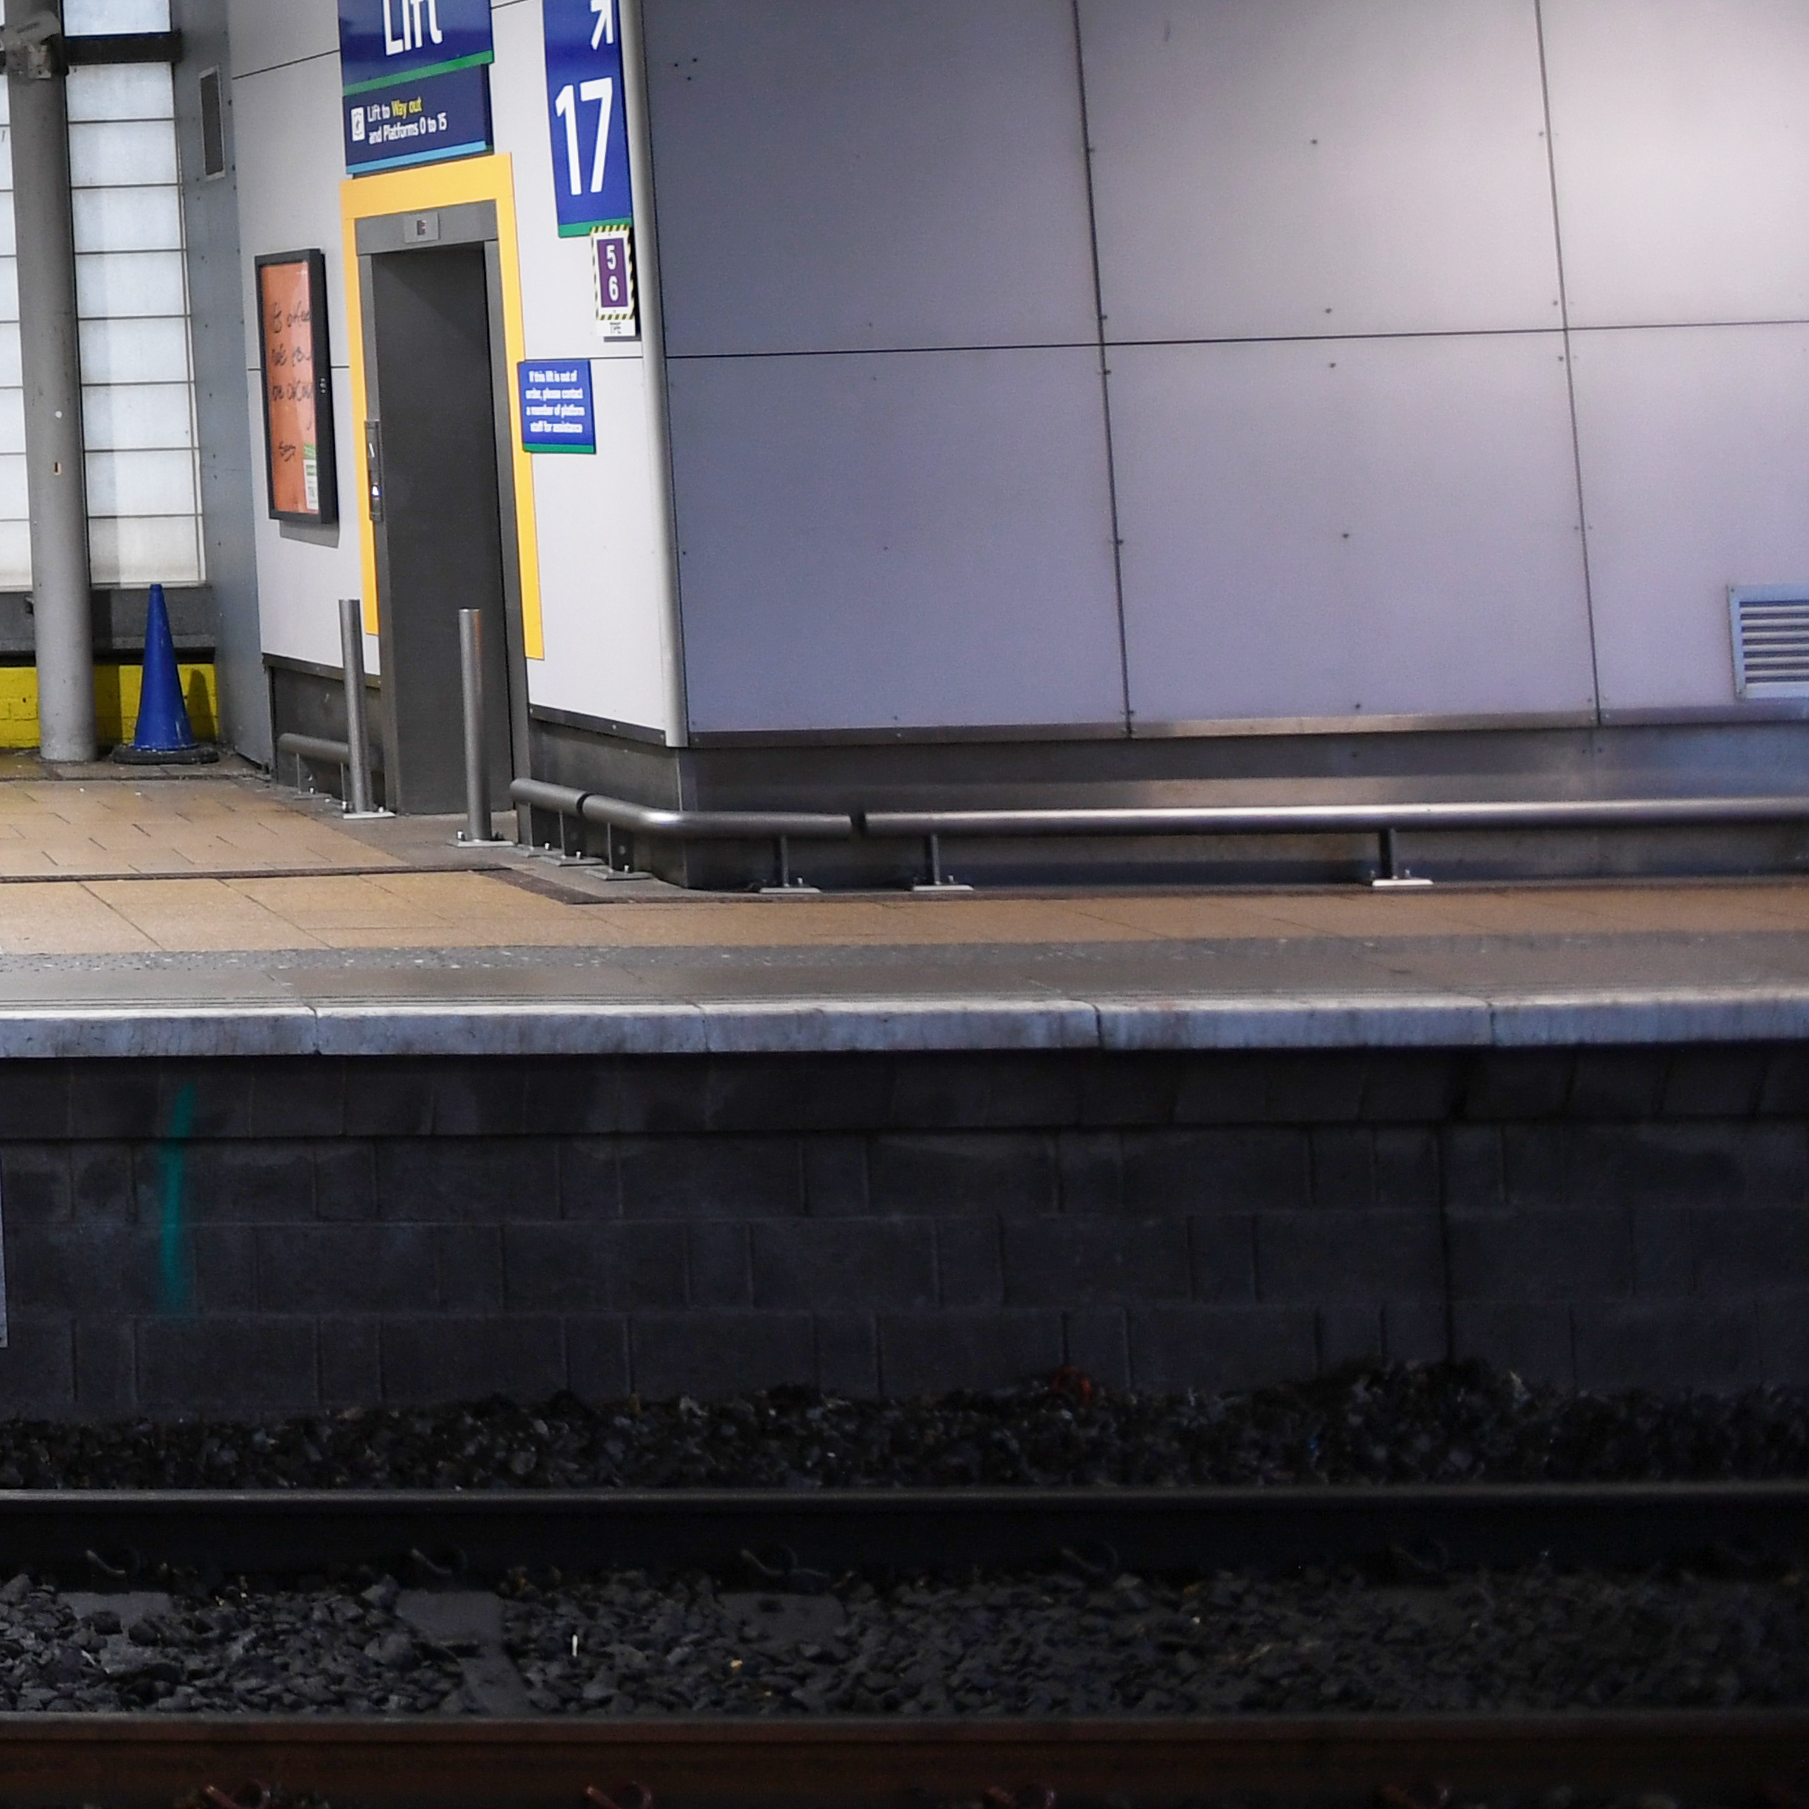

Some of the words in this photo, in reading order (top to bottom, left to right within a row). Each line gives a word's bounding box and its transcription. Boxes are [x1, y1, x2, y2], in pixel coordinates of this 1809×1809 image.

[367, 104, 381, 123] Lift
[382, 103, 390, 119] to
[391, 99, 408, 120] Way
[408, 96, 422, 113] out
[368, 126, 382, 145] and
[383, 122, 419, 141] Platforms
[419, 116, 426, 134] 0
[427, 117, 437, 133] to
[437, 112, 448, 131] 15
[554, 77, 613, 195] 17
[606, 244, 617, 271] 5
[608, 275, 619, 302] 6
